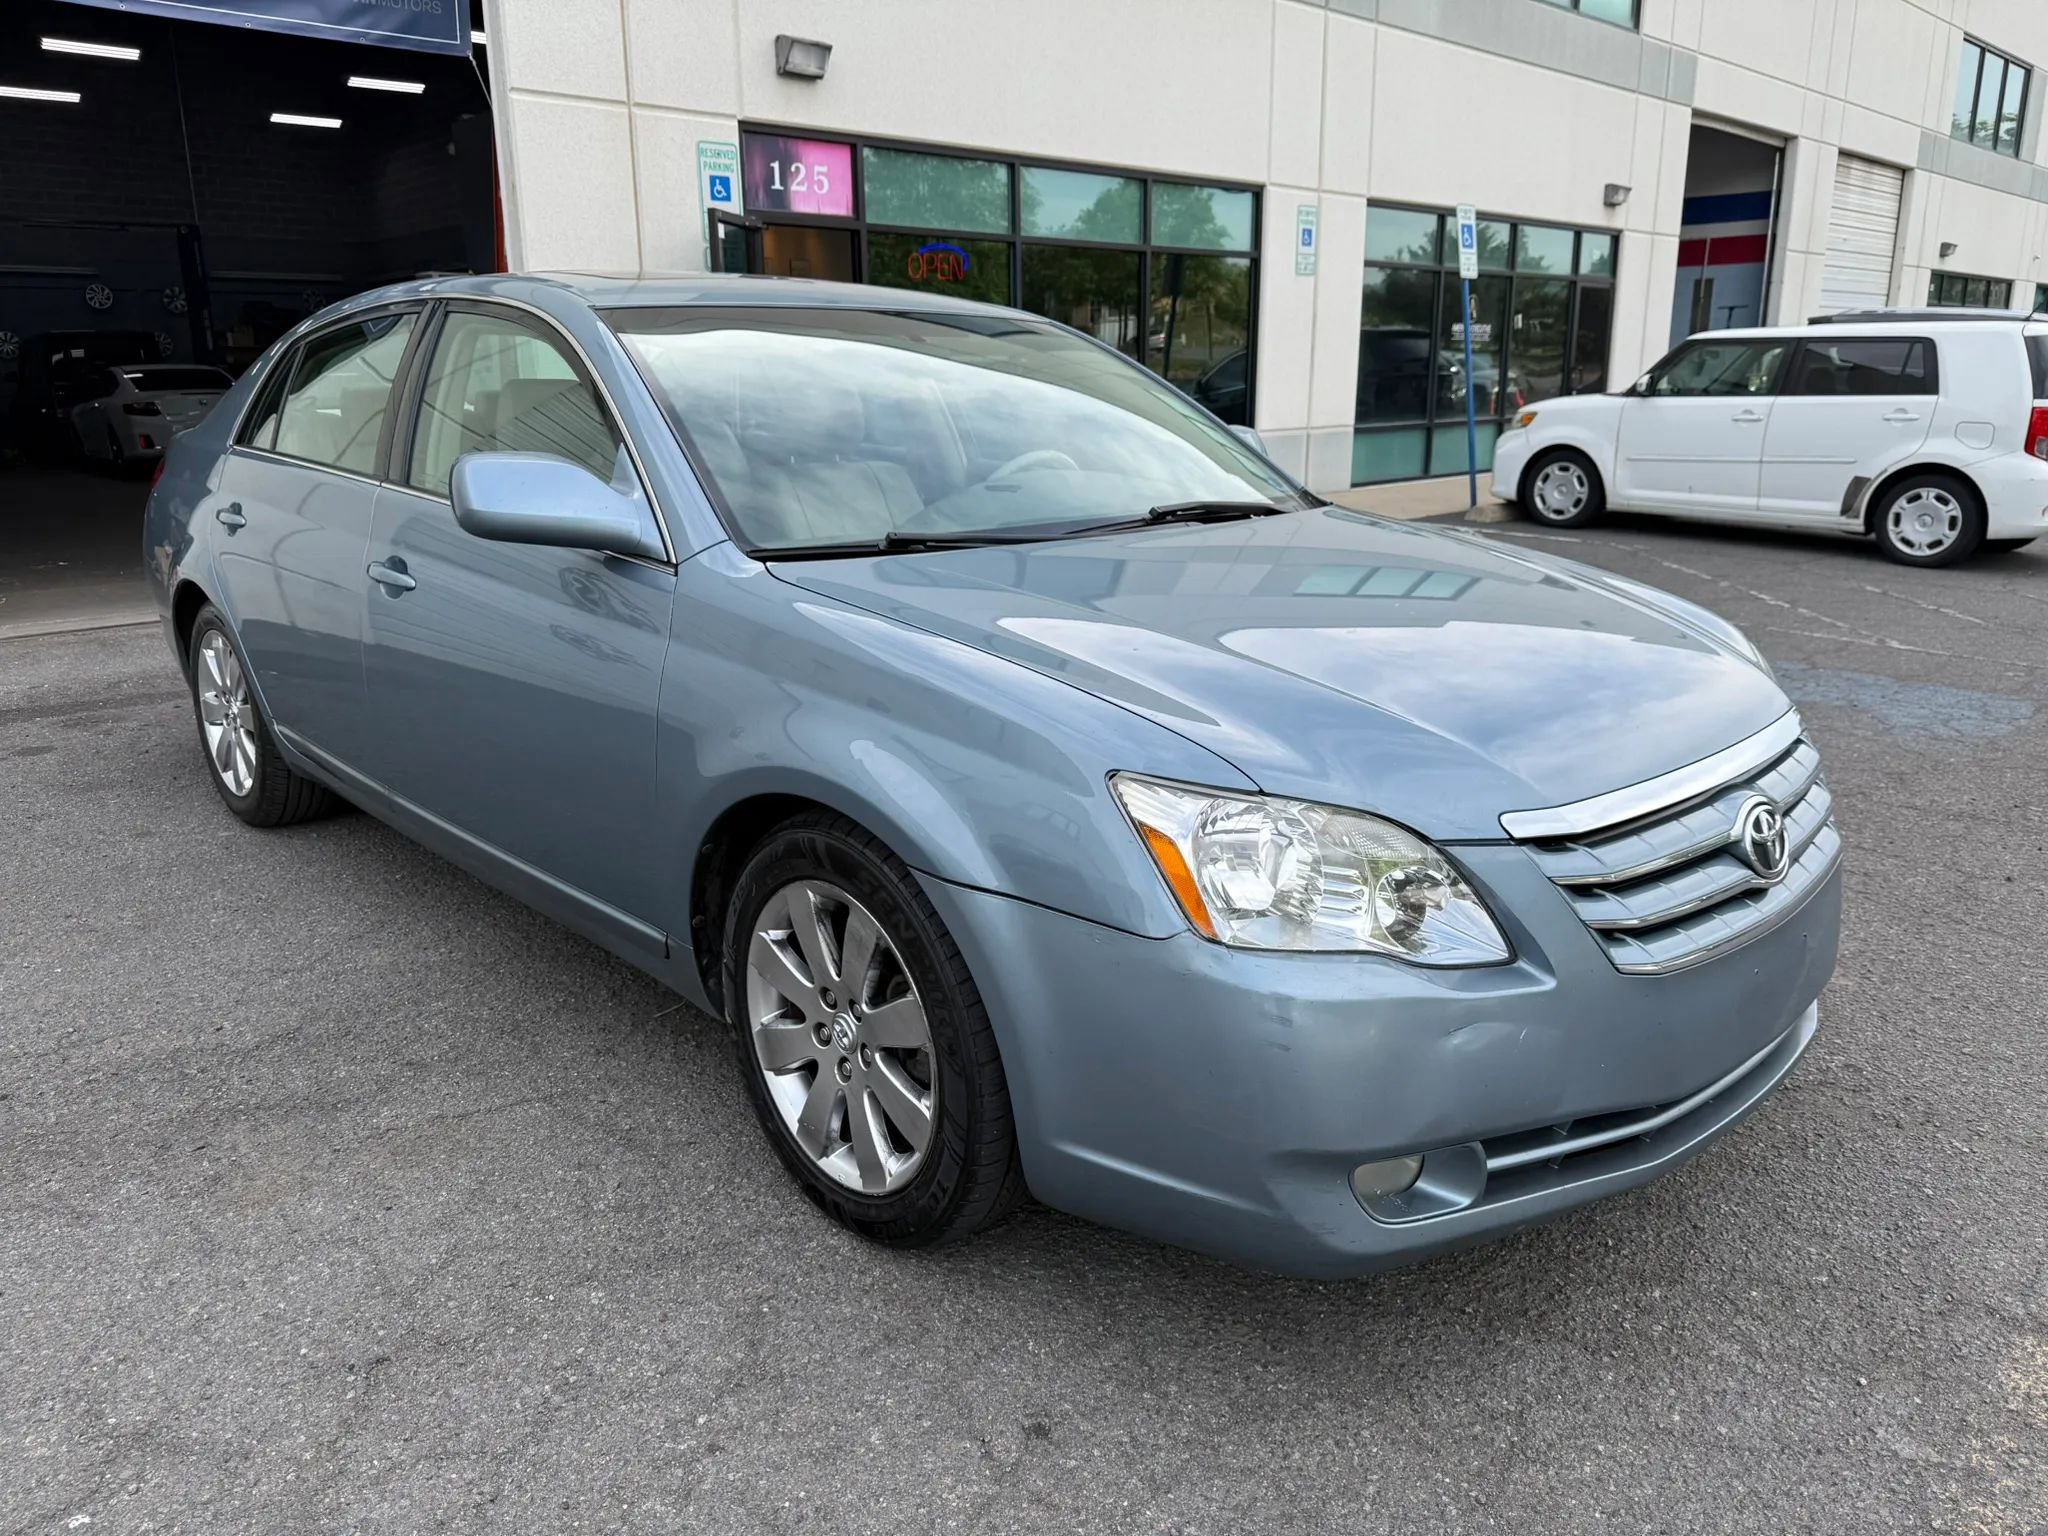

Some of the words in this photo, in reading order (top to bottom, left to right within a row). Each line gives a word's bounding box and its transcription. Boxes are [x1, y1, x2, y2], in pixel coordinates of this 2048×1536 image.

[700, 147, 736, 160] RESERVED
[703, 160, 735, 174] PARKING
[769, 160, 830, 194] 125
[908, 252, 964, 280] OPEN
